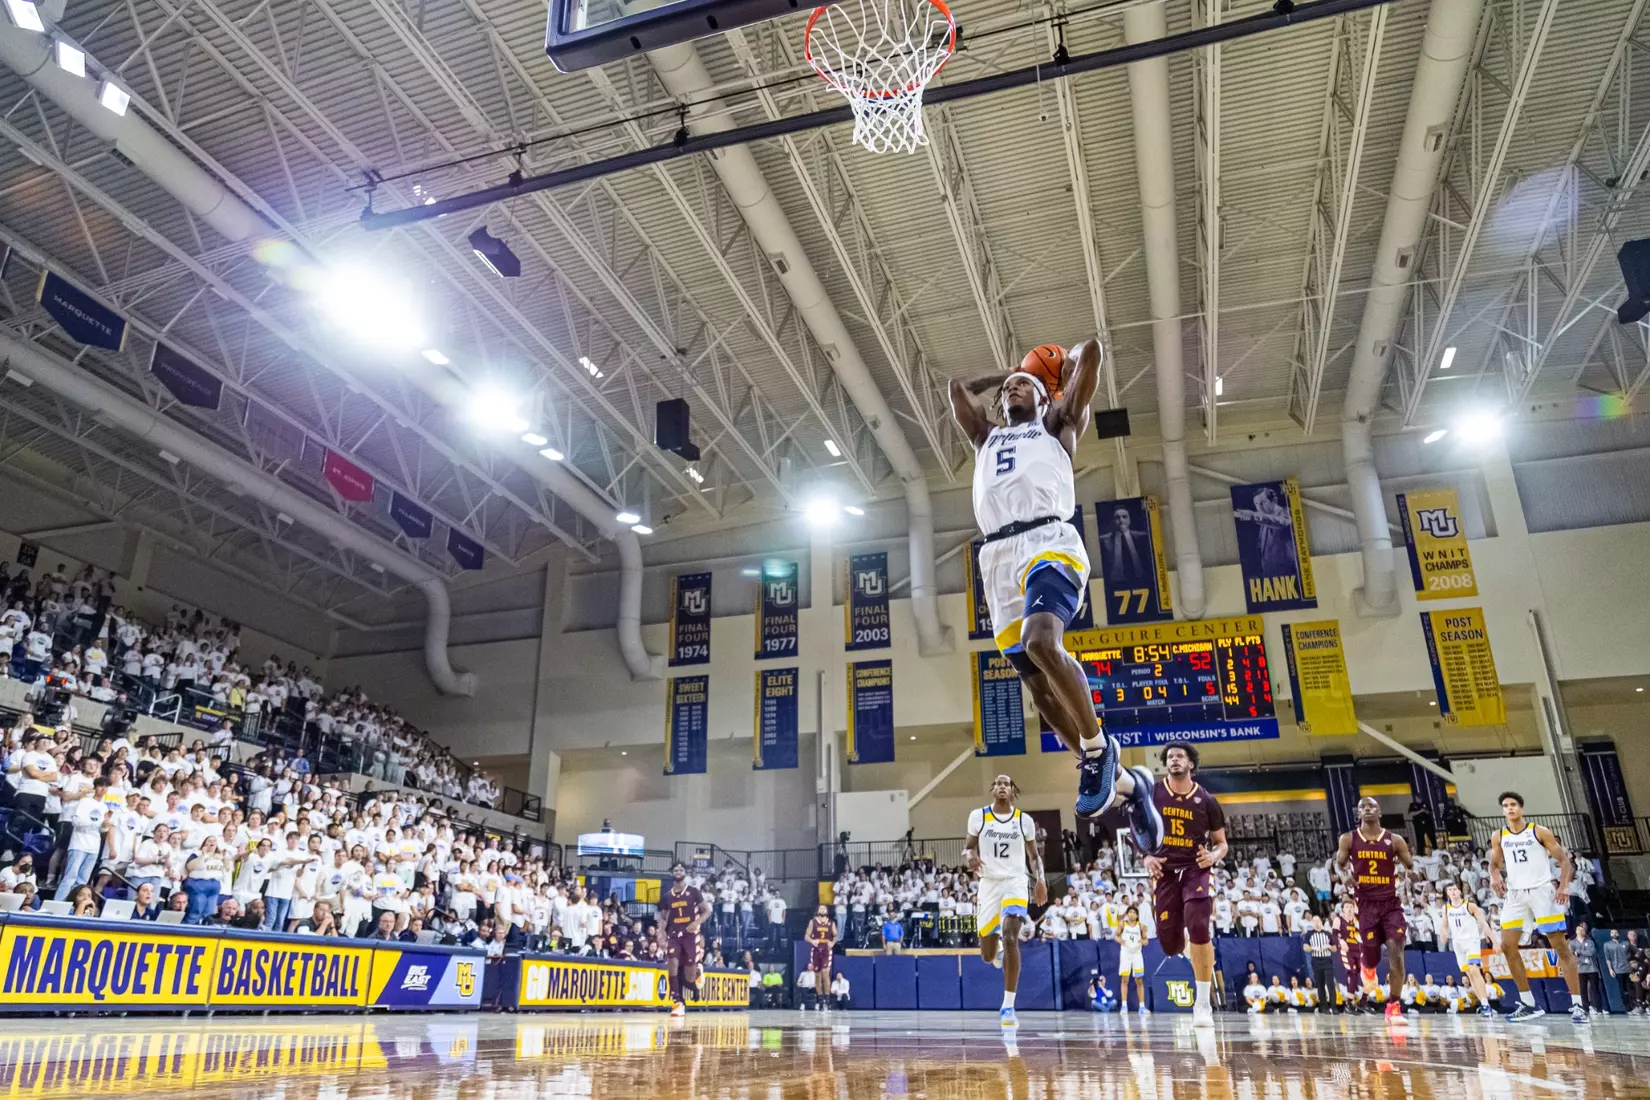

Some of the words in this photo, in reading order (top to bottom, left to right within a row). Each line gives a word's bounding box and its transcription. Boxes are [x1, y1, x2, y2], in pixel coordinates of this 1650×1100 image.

[54, 295, 112, 336] MARQUETTE
[996, 446, 1016, 476] 5
[1416, 508, 1459, 538] MU
[1425, 559, 1469, 572] CHAMPS
[857, 569, 885, 597] MU
[1429, 573, 1473, 591] 2008
[768, 580, 795, 606] MU
[1249, 575, 1299, 603] HANK
[681, 589, 708, 615] MU
[1114, 588, 1150, 616] 77
[854, 605, 888, 616] FINAL
[765, 615, 796, 626] FINAL
[855, 614, 888, 626] FOUR
[1445, 617, 1472, 628] POST
[679, 623, 709, 634] FINAL
[765, 624, 796, 635] FOUR
[1072, 628, 1162, 646] McGUIRE
[1176, 620, 1258, 638] CENTER
[1296, 628, 1337, 640] CONFERENCE
[679, 632, 709, 643] FOUR
[856, 628, 889, 643] 2003
[1218, 638, 1232, 647] PLY
[1235, 637, 1245, 646] FL
[1246, 636, 1261, 645] PTS
[1441, 629, 1483, 642] SEASON
[765, 637, 796, 651] 1977
[1298, 640, 1338, 651] CHAMPIONS
[678, 645, 708, 659] 1974
[1081, 650, 1121, 661] MARQUETTE
[1134, 645, 1170, 663] 8:54
[1228, 648, 1233, 657] 1
[1257, 644, 1265, 655] 7
[988, 658, 1011, 668] POST
[1189, 652, 1212, 670] 52
[1227, 659, 1234, 670] 2
[856, 667, 891, 678] CONFERENCE
[983, 668, 1019, 680] SEASON
[1091, 661, 1112, 676] 74
[1154, 664, 1163, 676] 2
[767, 675, 793, 687] ELITE
[857, 676, 890, 688] CHAMPIONS
[1229, 671, 1236, 682] 3
[678, 682, 704, 693] SWEET
[1132, 680, 1154, 688] PLAYER
[1183, 684, 1187, 696] 1
[1206, 682, 1215, 695] 5
[1227, 683, 1238, 694] 15
[766, 686, 793, 697] EIGHT
[1092, 690, 1102, 703] 6
[1116, 688, 1124, 701] 3
[676, 692, 705, 704] SIXTEEN
[1225, 696, 1239, 705] 44
[1155, 729, 1227, 742] WISCONSIN'S
[1230, 726, 1261, 738] BANK
[1163, 807, 1193, 820] CENTRAL
[1171, 819, 1185, 836] 15
[985, 829, 1020, 840] Marquette
[993, 843, 1009, 858] 12
[1358, 851, 1387, 860] CENTRAL
[1512, 849, 1528, 863] 13
[1369, 860, 1378, 875] 2
[1359, 876, 1390, 884] MICHIGAN
[678, 907, 683, 917] 1
[1455, 919, 1462, 928] 11
[3, 935, 206, 1000] MARQUETTE
[216, 947, 361, 997] BASKETBALL
[408, 965, 428, 976] BIG
[404, 974, 431, 985] EAST
[455, 961, 477, 997] MU
[722, 977, 748, 1001] CENTER
[1166, 981, 1195, 1007] MU
